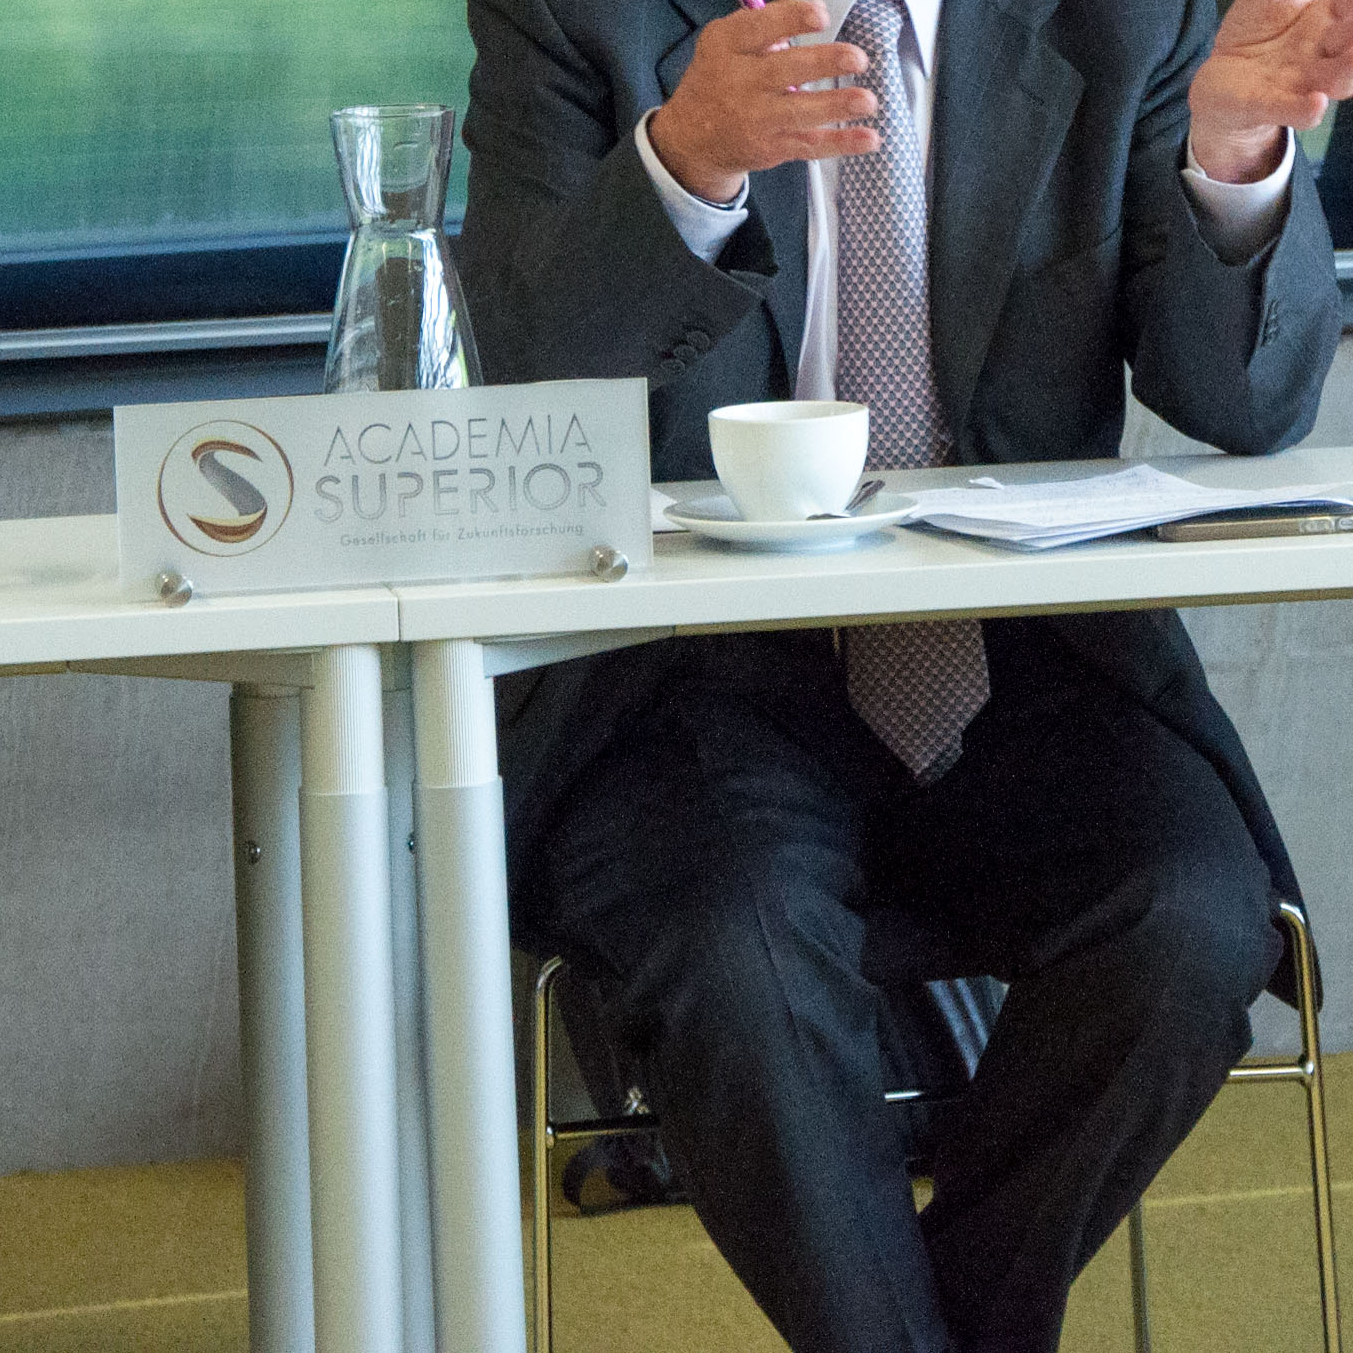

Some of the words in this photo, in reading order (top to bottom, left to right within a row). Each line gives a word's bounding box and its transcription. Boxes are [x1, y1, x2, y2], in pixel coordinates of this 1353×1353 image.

[324, 412, 593, 467] ACADEMIA
[314, 461, 607, 523] SUPERIOR
[340, 528, 426, 546] Gesellschaft
[458, 523, 584, 540] Zukunftsforschung
